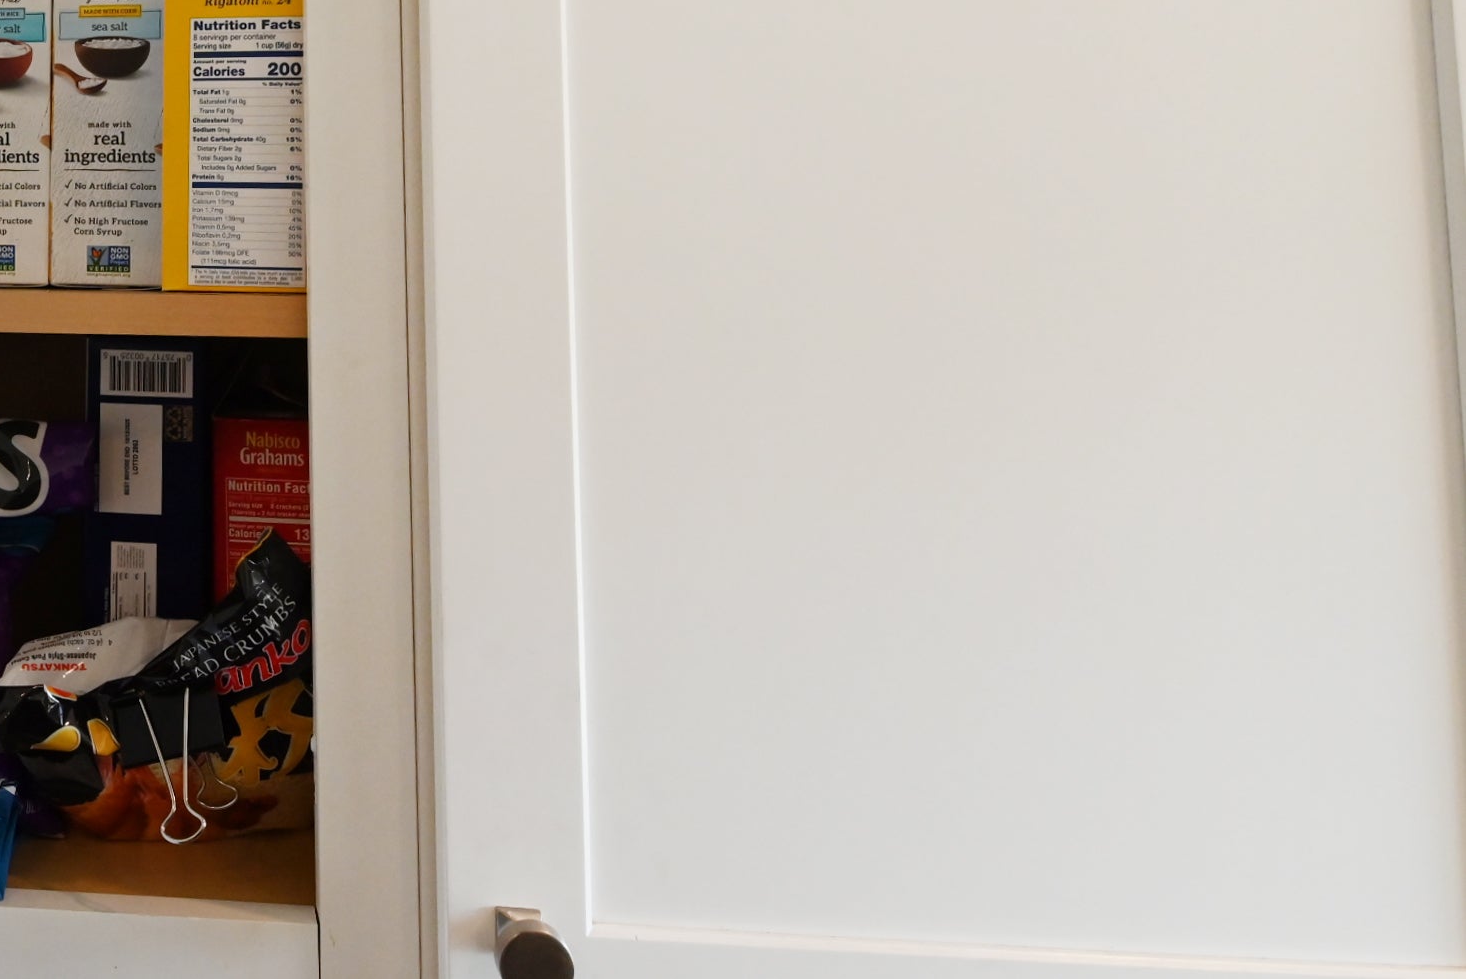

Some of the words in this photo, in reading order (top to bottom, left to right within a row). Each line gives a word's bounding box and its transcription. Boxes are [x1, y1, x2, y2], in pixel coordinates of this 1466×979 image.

[3, 24, 21, 33] salt
[91, 23, 108, 31] sea
[111, 22, 128, 31] salt
[193, 20, 256, 31] Nutrition
[262, 20, 301, 30] Facts
[193, 67, 245, 77] Calories
[268, 63, 301, 76] 200
[93, 131, 126, 145] real
[65, 149, 156, 166] ingredients
[74, 182, 86, 190] No
[89, 182, 127, 190] Artificial
[130, 200, 162, 208] Flavors
[74, 217, 86, 225] No
[89, 217, 109, 226] High
[112, 218, 149, 226] Fructose
[97, 228, 122, 237] Syrup
[246, 431, 300, 449] Nabisco
[240, 447, 305, 467] Grahams
[228, 480, 280, 493] Nutrition
[172, 621, 241, 673] JAPANESE
[242, 583, 283, 626] STYLE
[223, 596, 297, 662] CRUMBS
[215, 618, 311, 696] anko
[21, 663, 87, 671] TONKATSU
